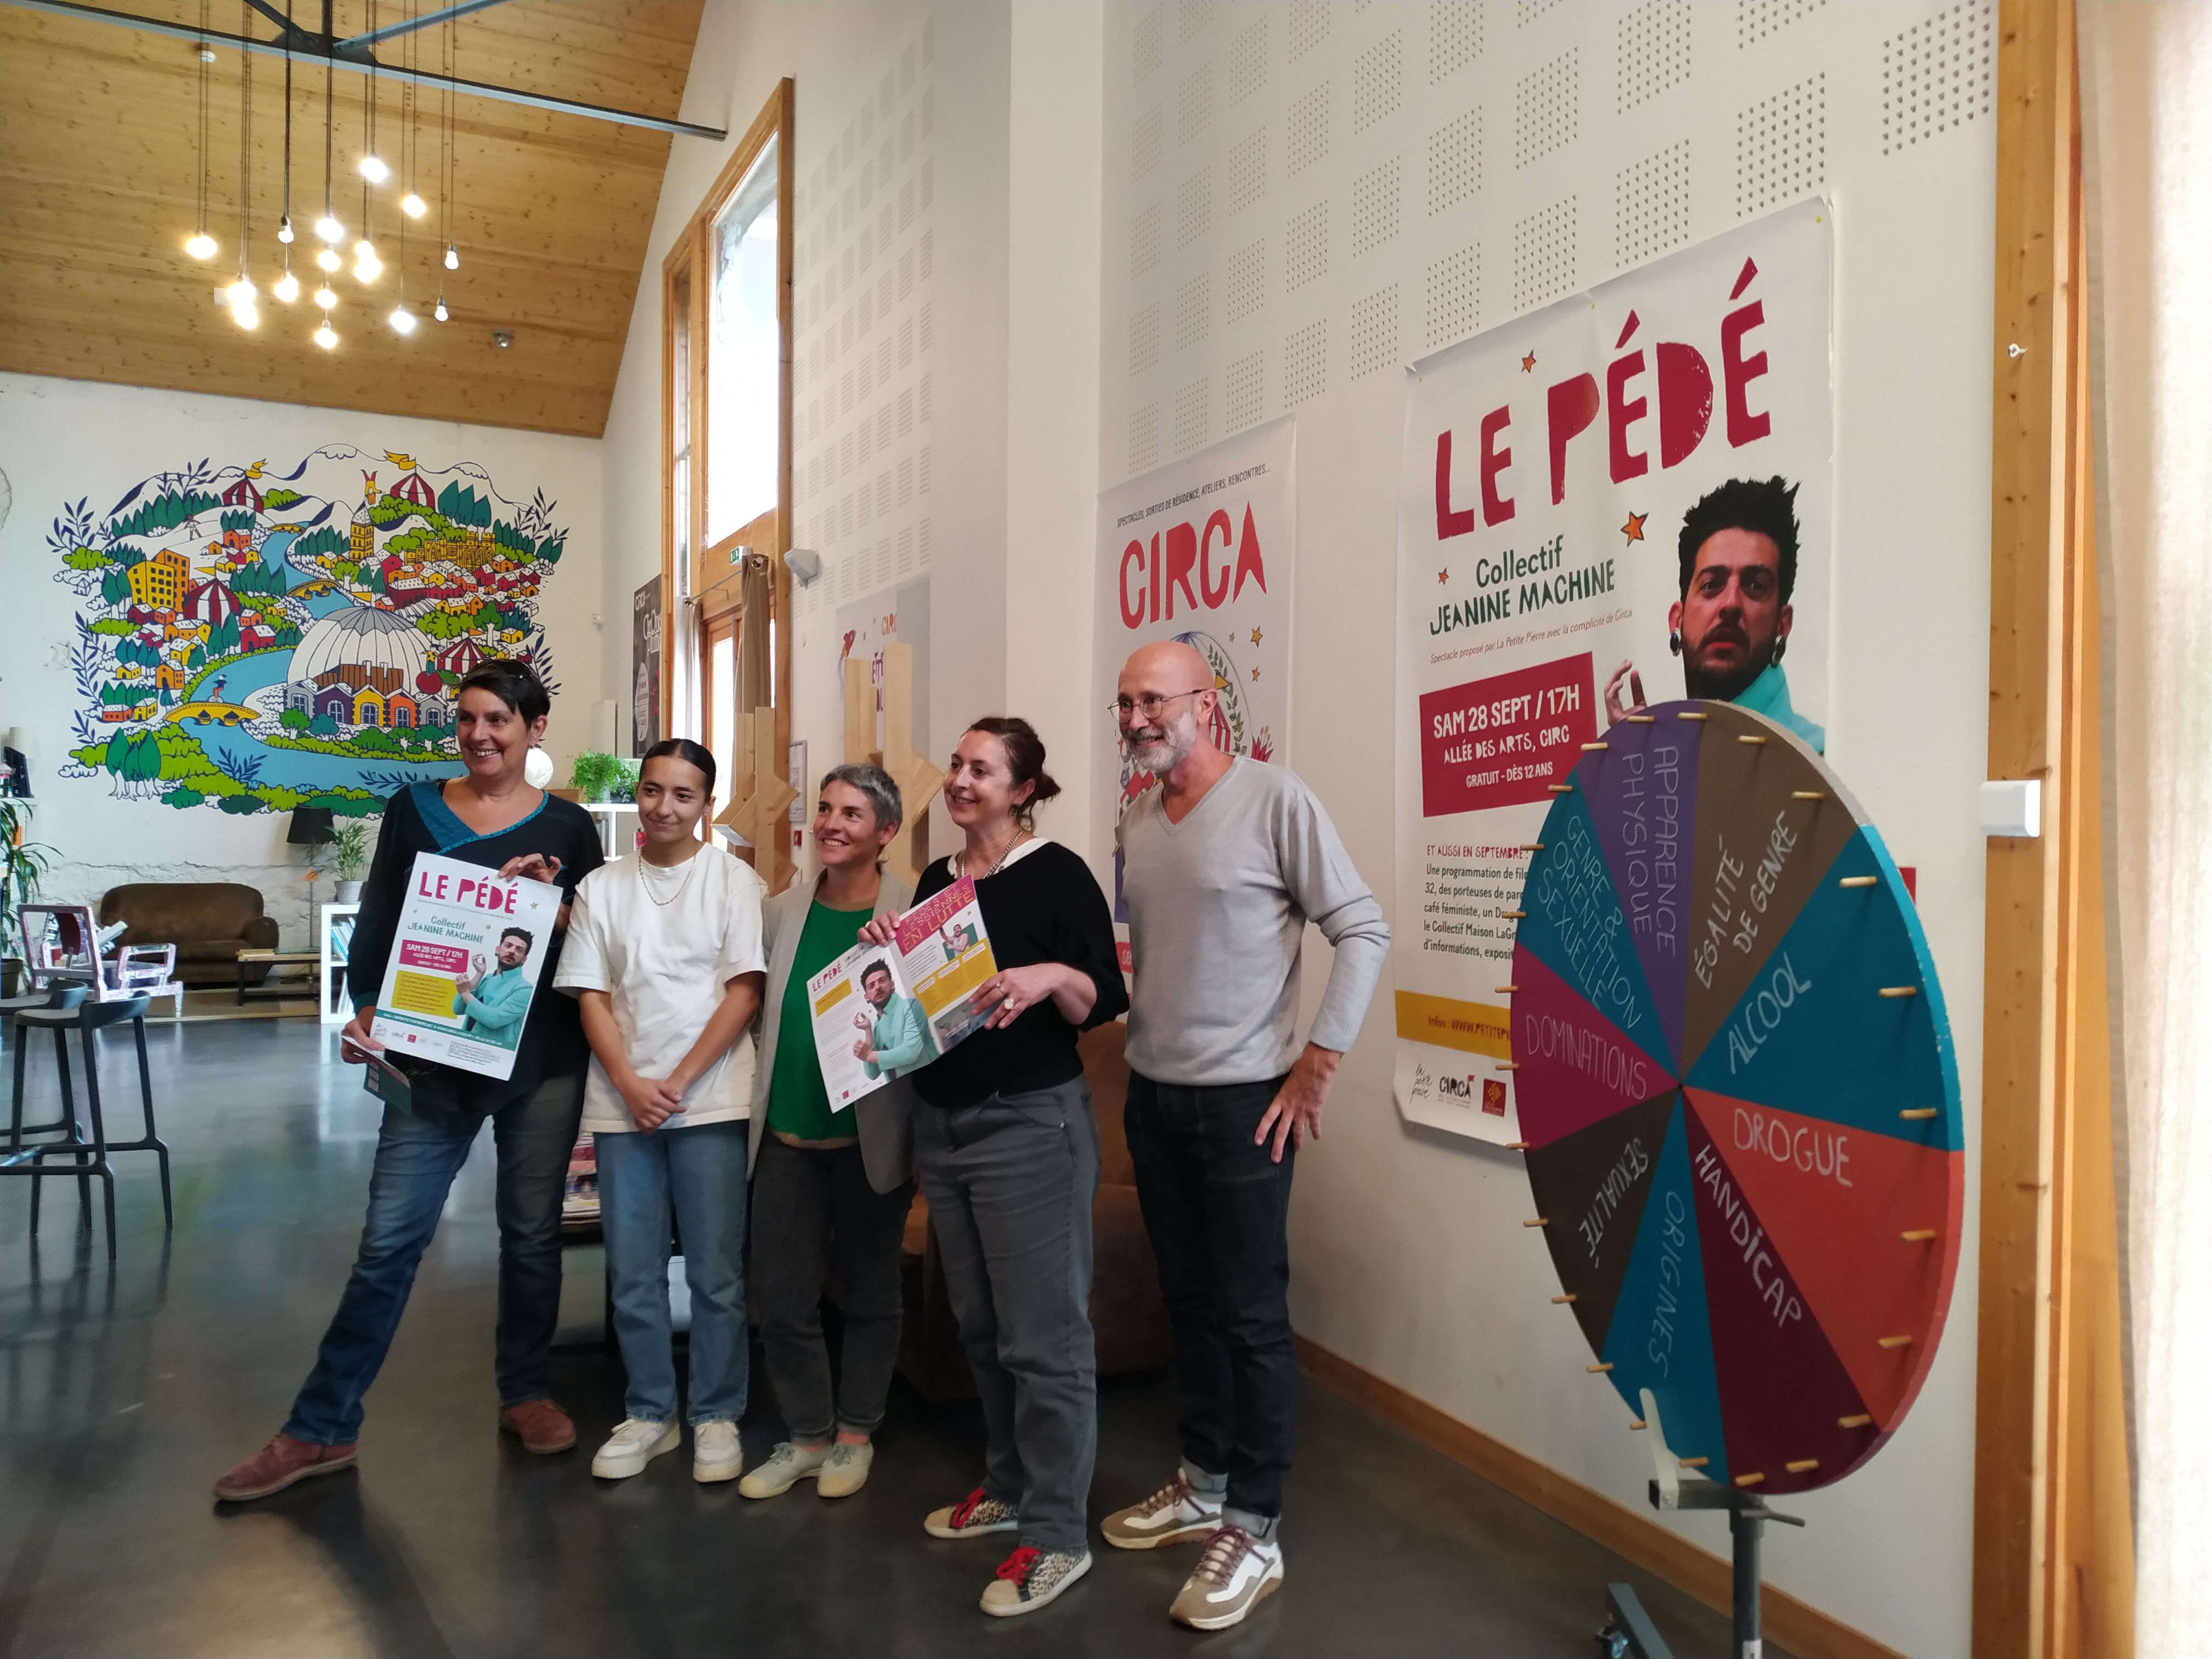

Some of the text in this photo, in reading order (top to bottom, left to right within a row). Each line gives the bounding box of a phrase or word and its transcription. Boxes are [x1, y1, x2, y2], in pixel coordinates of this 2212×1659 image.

[1435, 256, 1771, 541] LE PÉDÉ
[1146, 502, 1164, 517] SORTIES
[1165, 499, 1171, 510] DE
[1172, 488, 1200, 507] RÉSIDENCE,
[1201, 478, 1227, 496] ATELIERS,
[1120, 500, 1267, 629] CIRCA
[1476, 534, 1564, 588] Collectif
[1429, 557, 1615, 635] JEANINE MACHINE
[1430, 608, 1633, 664] Spectacle proposé par La Petite Pierre avec la complicité de Circa
[1434, 684, 1579, 739] SAM 28 SEPT / 17H
[1444, 725, 1570, 765] ALLÉE DES ARTS, CIRC
[1466, 770, 1499, 788] GRATUIT
[1506, 764, 1523, 782] DÈS
[1525, 765, 1533, 779] 12
[1535, 761, 1553, 777] ANS
[1426, 863, 1440, 876] Une
[1442, 867, 1501, 879] programmation
[1503, 867, 1514, 879] de
[1427, 845, 1435, 856] ET
[1437, 845, 1460, 857] AUSSI
[1463, 846, 1472, 857] EN
[1475, 847, 1523, 859] SEPTEMBRE
[1622, 753, 1652, 934] PHYSIQUE
[1653, 746, 1681, 958] APPARENCE
[419, 872, 449, 900] LE
[456, 875, 518, 914] PÉDÉ
[1425, 882, 1437, 895] 32,
[1439, 883, 1451, 895] des
[1454, 885, 1492, 899] porteuses
[1494, 885, 1504, 899] de
[1567, 815, 1623, 941] GENRE &
[1733, 810, 1798, 955] DE GENRE
[408, 922, 484, 944] JEANINE MACHINE
[431, 916, 466, 930] Collectif
[902, 890, 974, 951] EN LUTTE
[1424, 901, 1440, 914] café
[1442, 903, 1481, 919] féministe,
[1483, 908, 1493, 918] un
[1424, 919, 1430, 931] le
[1432, 921, 1464, 934] Collectif
[1466, 924, 1493, 938] Maison
[1553, 840, 1643, 1029] ORIENTATION
[1695, 835, 1745, 990] ÉGALITÉ
[407, 943, 420, 952] SAM
[430, 947, 447, 956] SEPT
[1424, 938, 1482, 958] d'informations,
[1538, 867, 1601, 1012] SEXUELLE
[812, 978, 821, 992] LE
[823, 960, 842, 984] PÉDÉ
[1429, 1015, 1446, 1028] Infos
[1727, 951, 1813, 1075] ALCOOL
[1526, 1014, 1647, 1100] DOMINATIONS
[1439, 1076, 1471, 1099] CIRCA
[1733, 1107, 1854, 1188] DROGUE
[1578, 1137, 1649, 1269] SEXUALITÉ
[1648, 1190, 1686, 1379] ORIGINES
